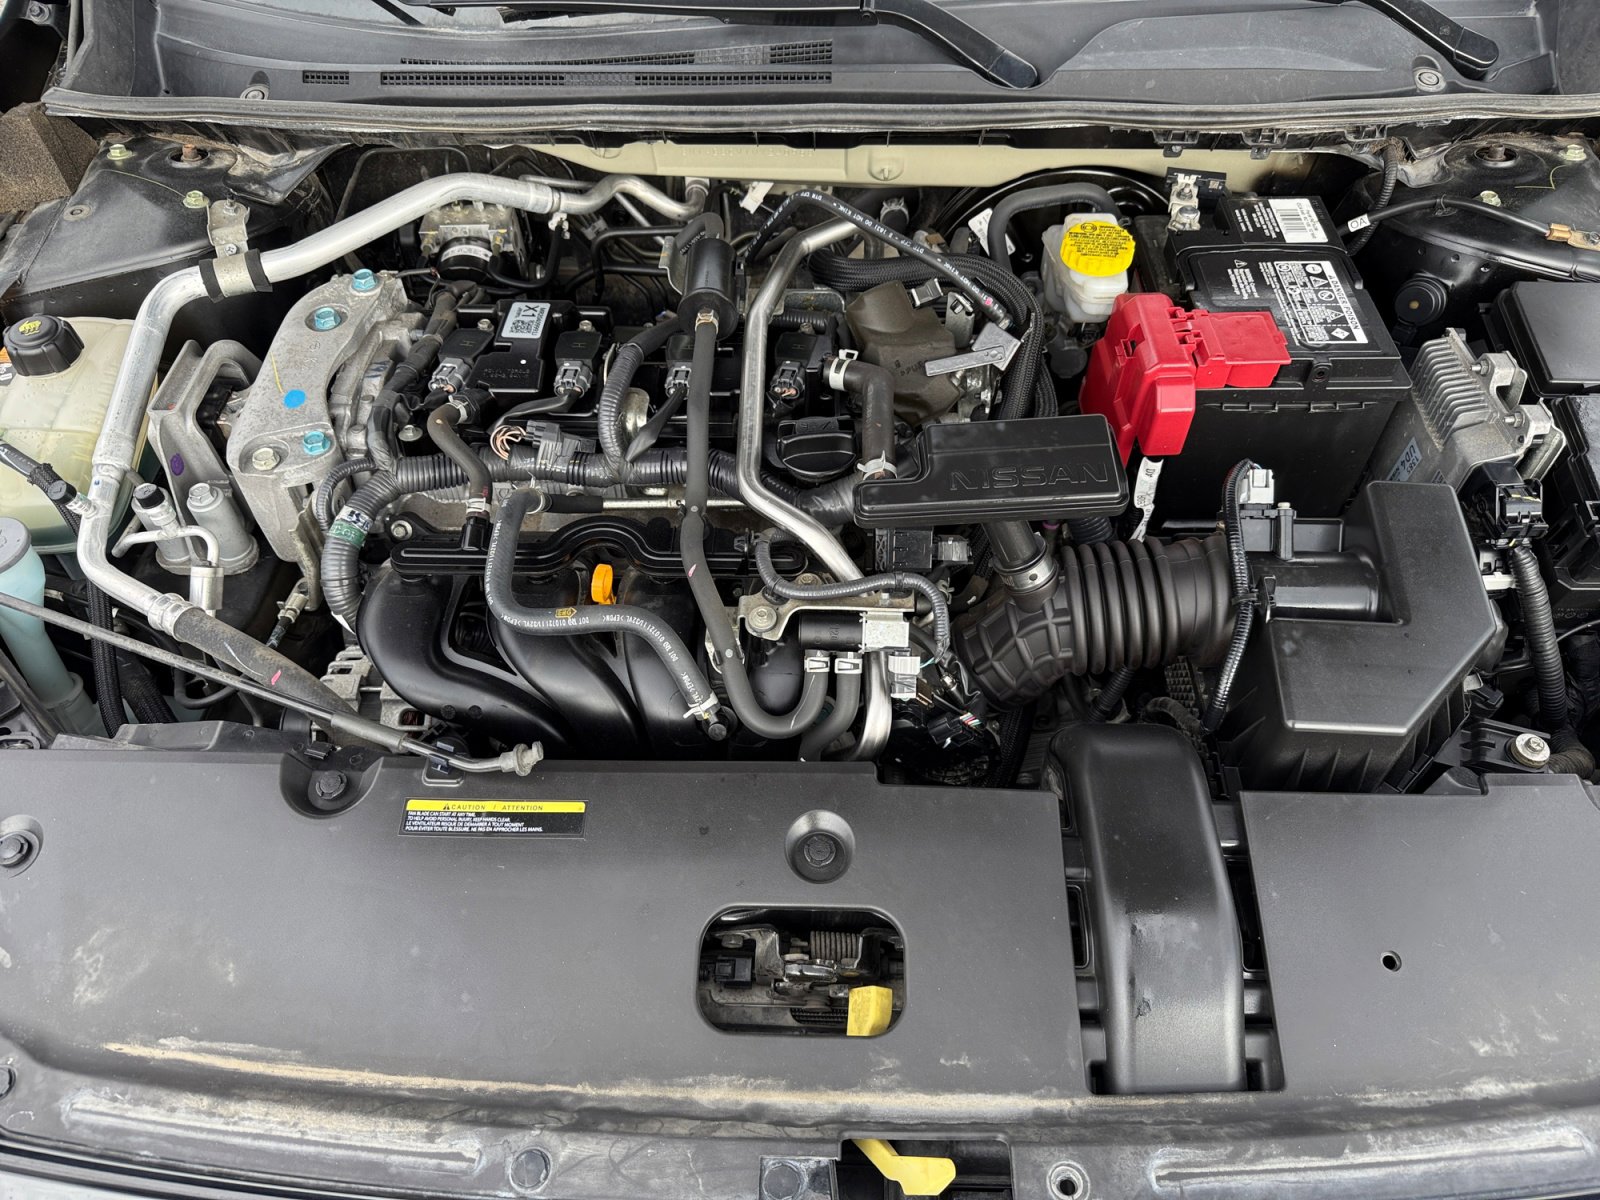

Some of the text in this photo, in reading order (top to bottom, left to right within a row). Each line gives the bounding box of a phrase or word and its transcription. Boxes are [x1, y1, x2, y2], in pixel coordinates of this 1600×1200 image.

[1331, 280, 1361, 330] DANGER POISON
[949, 462, 1108, 491] NISSAN
